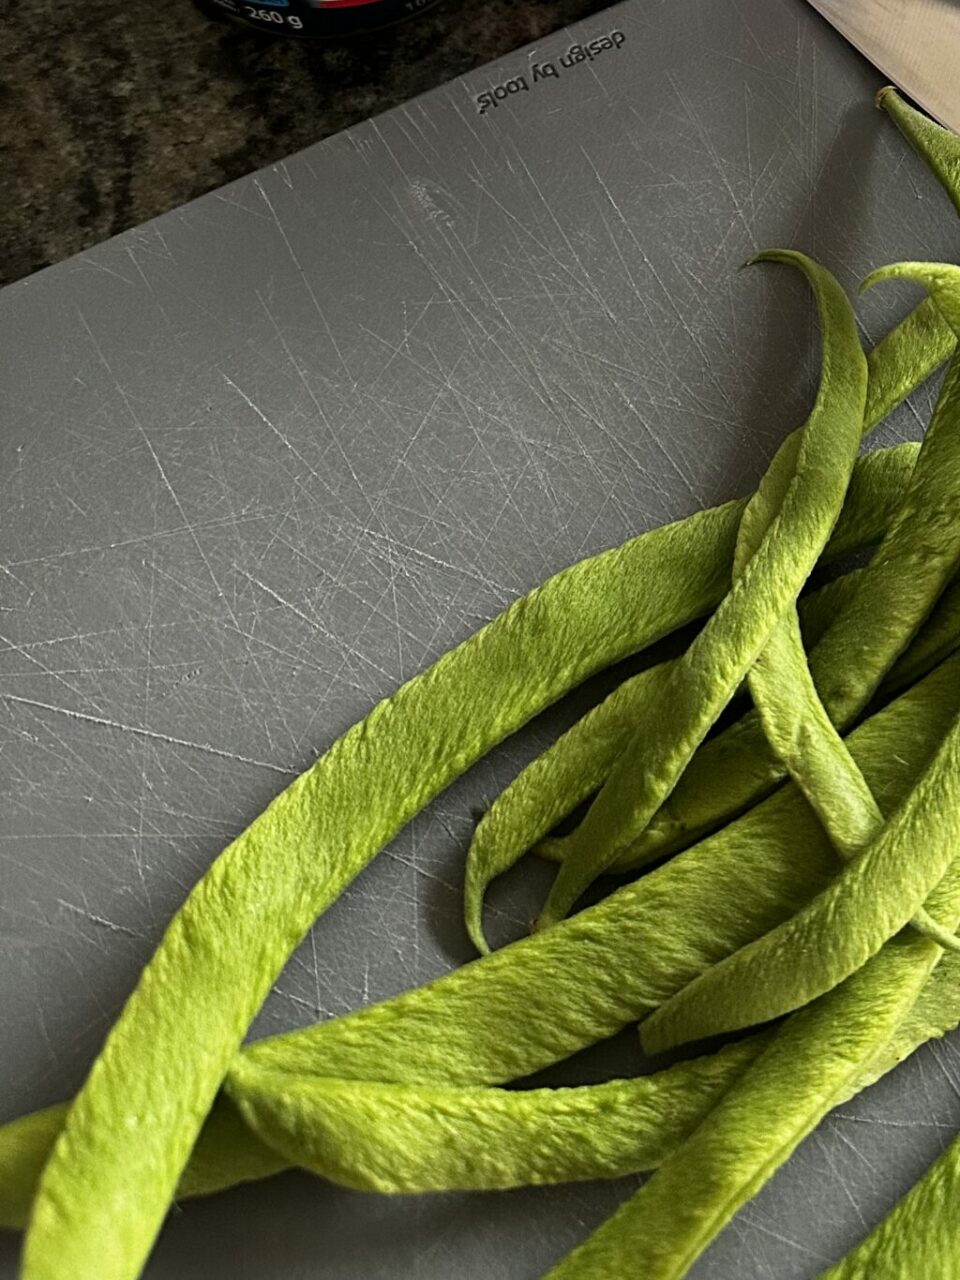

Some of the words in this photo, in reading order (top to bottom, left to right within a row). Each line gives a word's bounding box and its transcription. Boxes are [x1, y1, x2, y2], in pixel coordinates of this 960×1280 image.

[245, 6, 284, 24] 260
[287, 15, 303, 29] g
[559, 31, 626, 68] design
[531, 63, 559, 83] by
